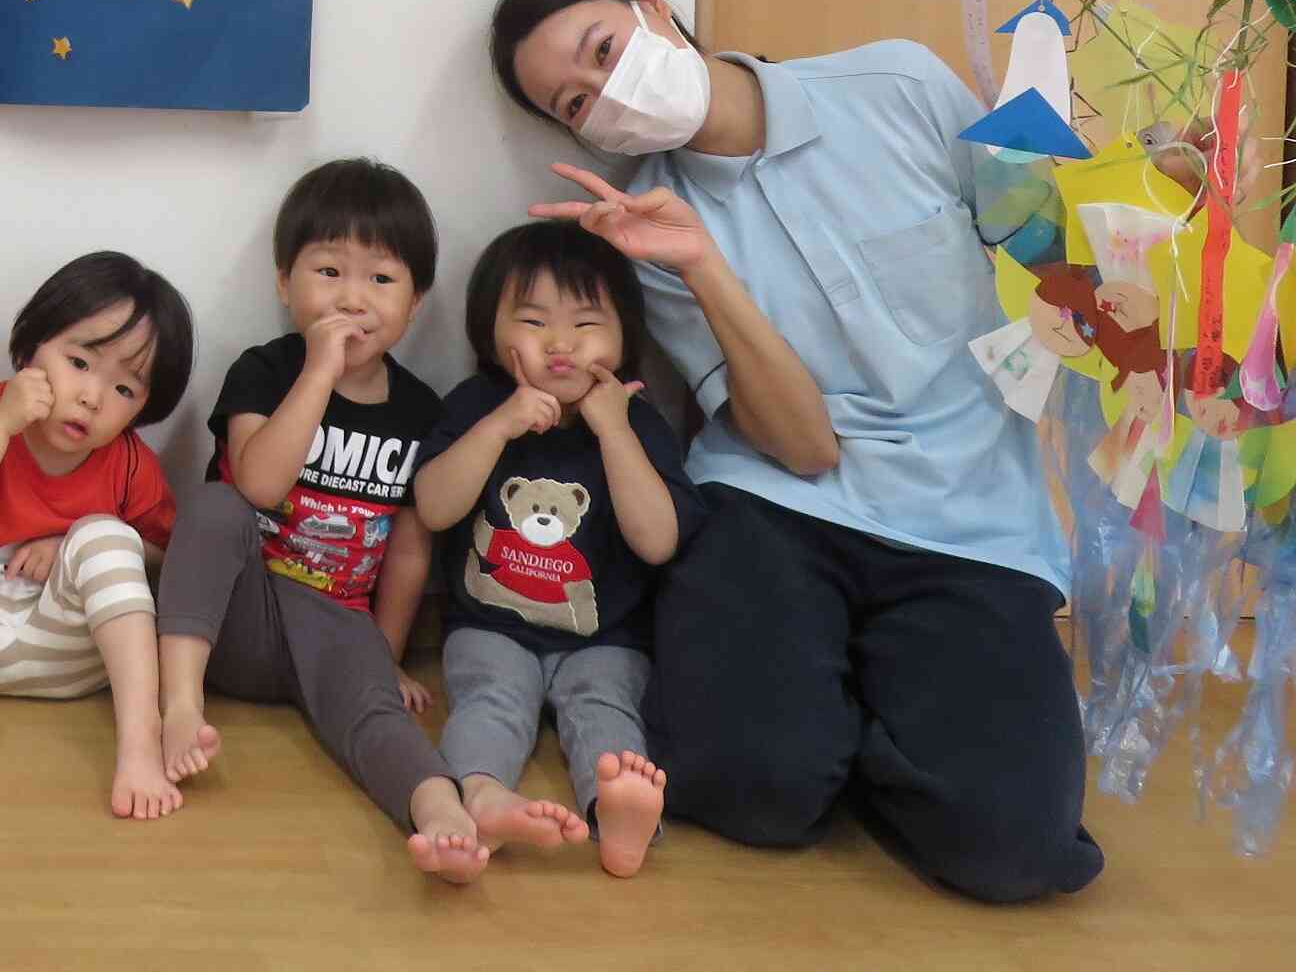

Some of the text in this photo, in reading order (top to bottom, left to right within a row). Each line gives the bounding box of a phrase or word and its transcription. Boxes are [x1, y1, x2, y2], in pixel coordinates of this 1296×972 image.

[321, 474, 366, 493] DIECAST
[367, 482, 389, 498] CAR
[300, 495, 335, 512] Which
[501, 546, 574, 574] SANDIEGO
[509, 563, 561, 582] CALIFORNIA
